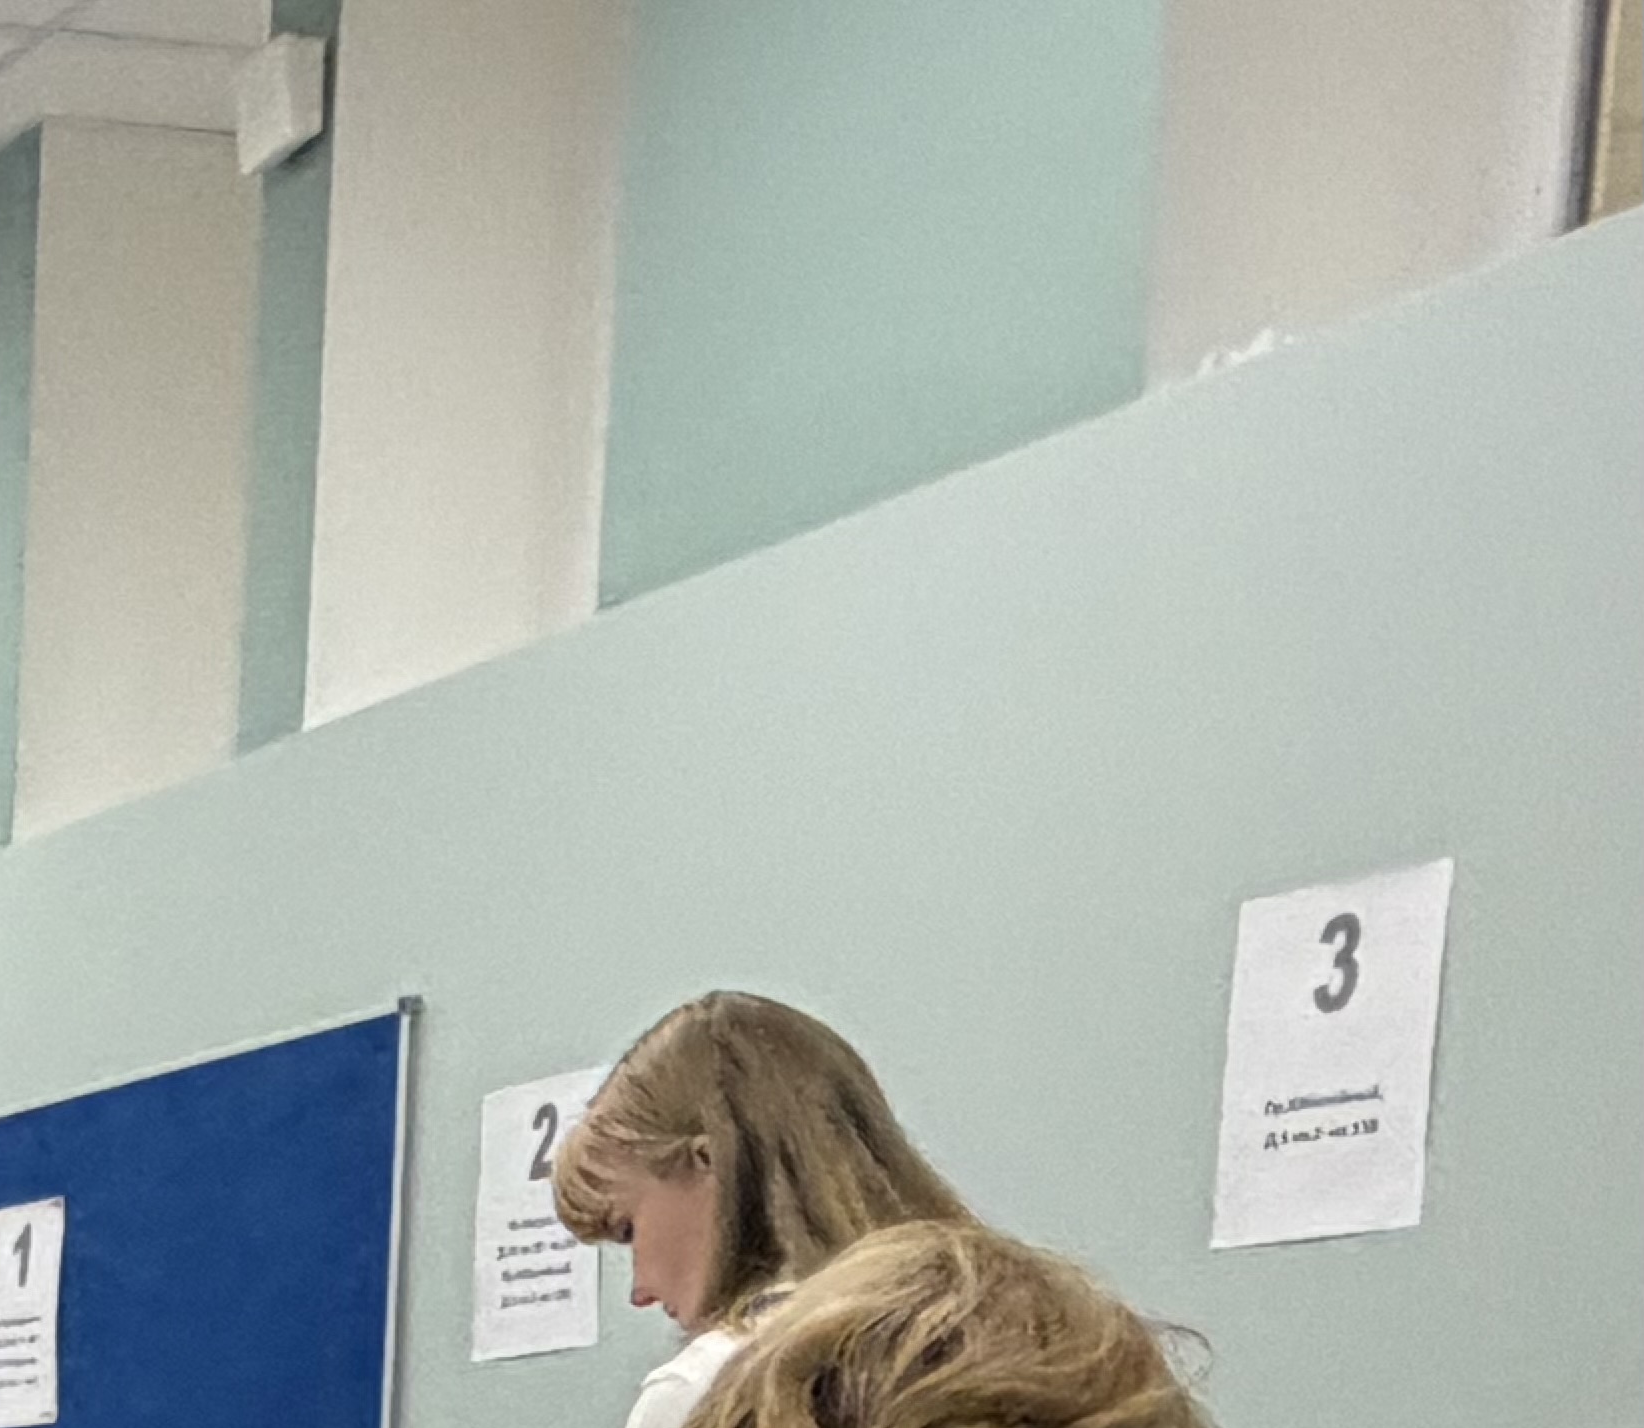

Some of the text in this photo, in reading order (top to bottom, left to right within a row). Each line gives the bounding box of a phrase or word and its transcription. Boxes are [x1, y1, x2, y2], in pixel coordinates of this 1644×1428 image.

[1313, 912, 1361, 1013] 3
[528, 1101, 559, 1181] 2
[12, 1222, 32, 1289] 1
